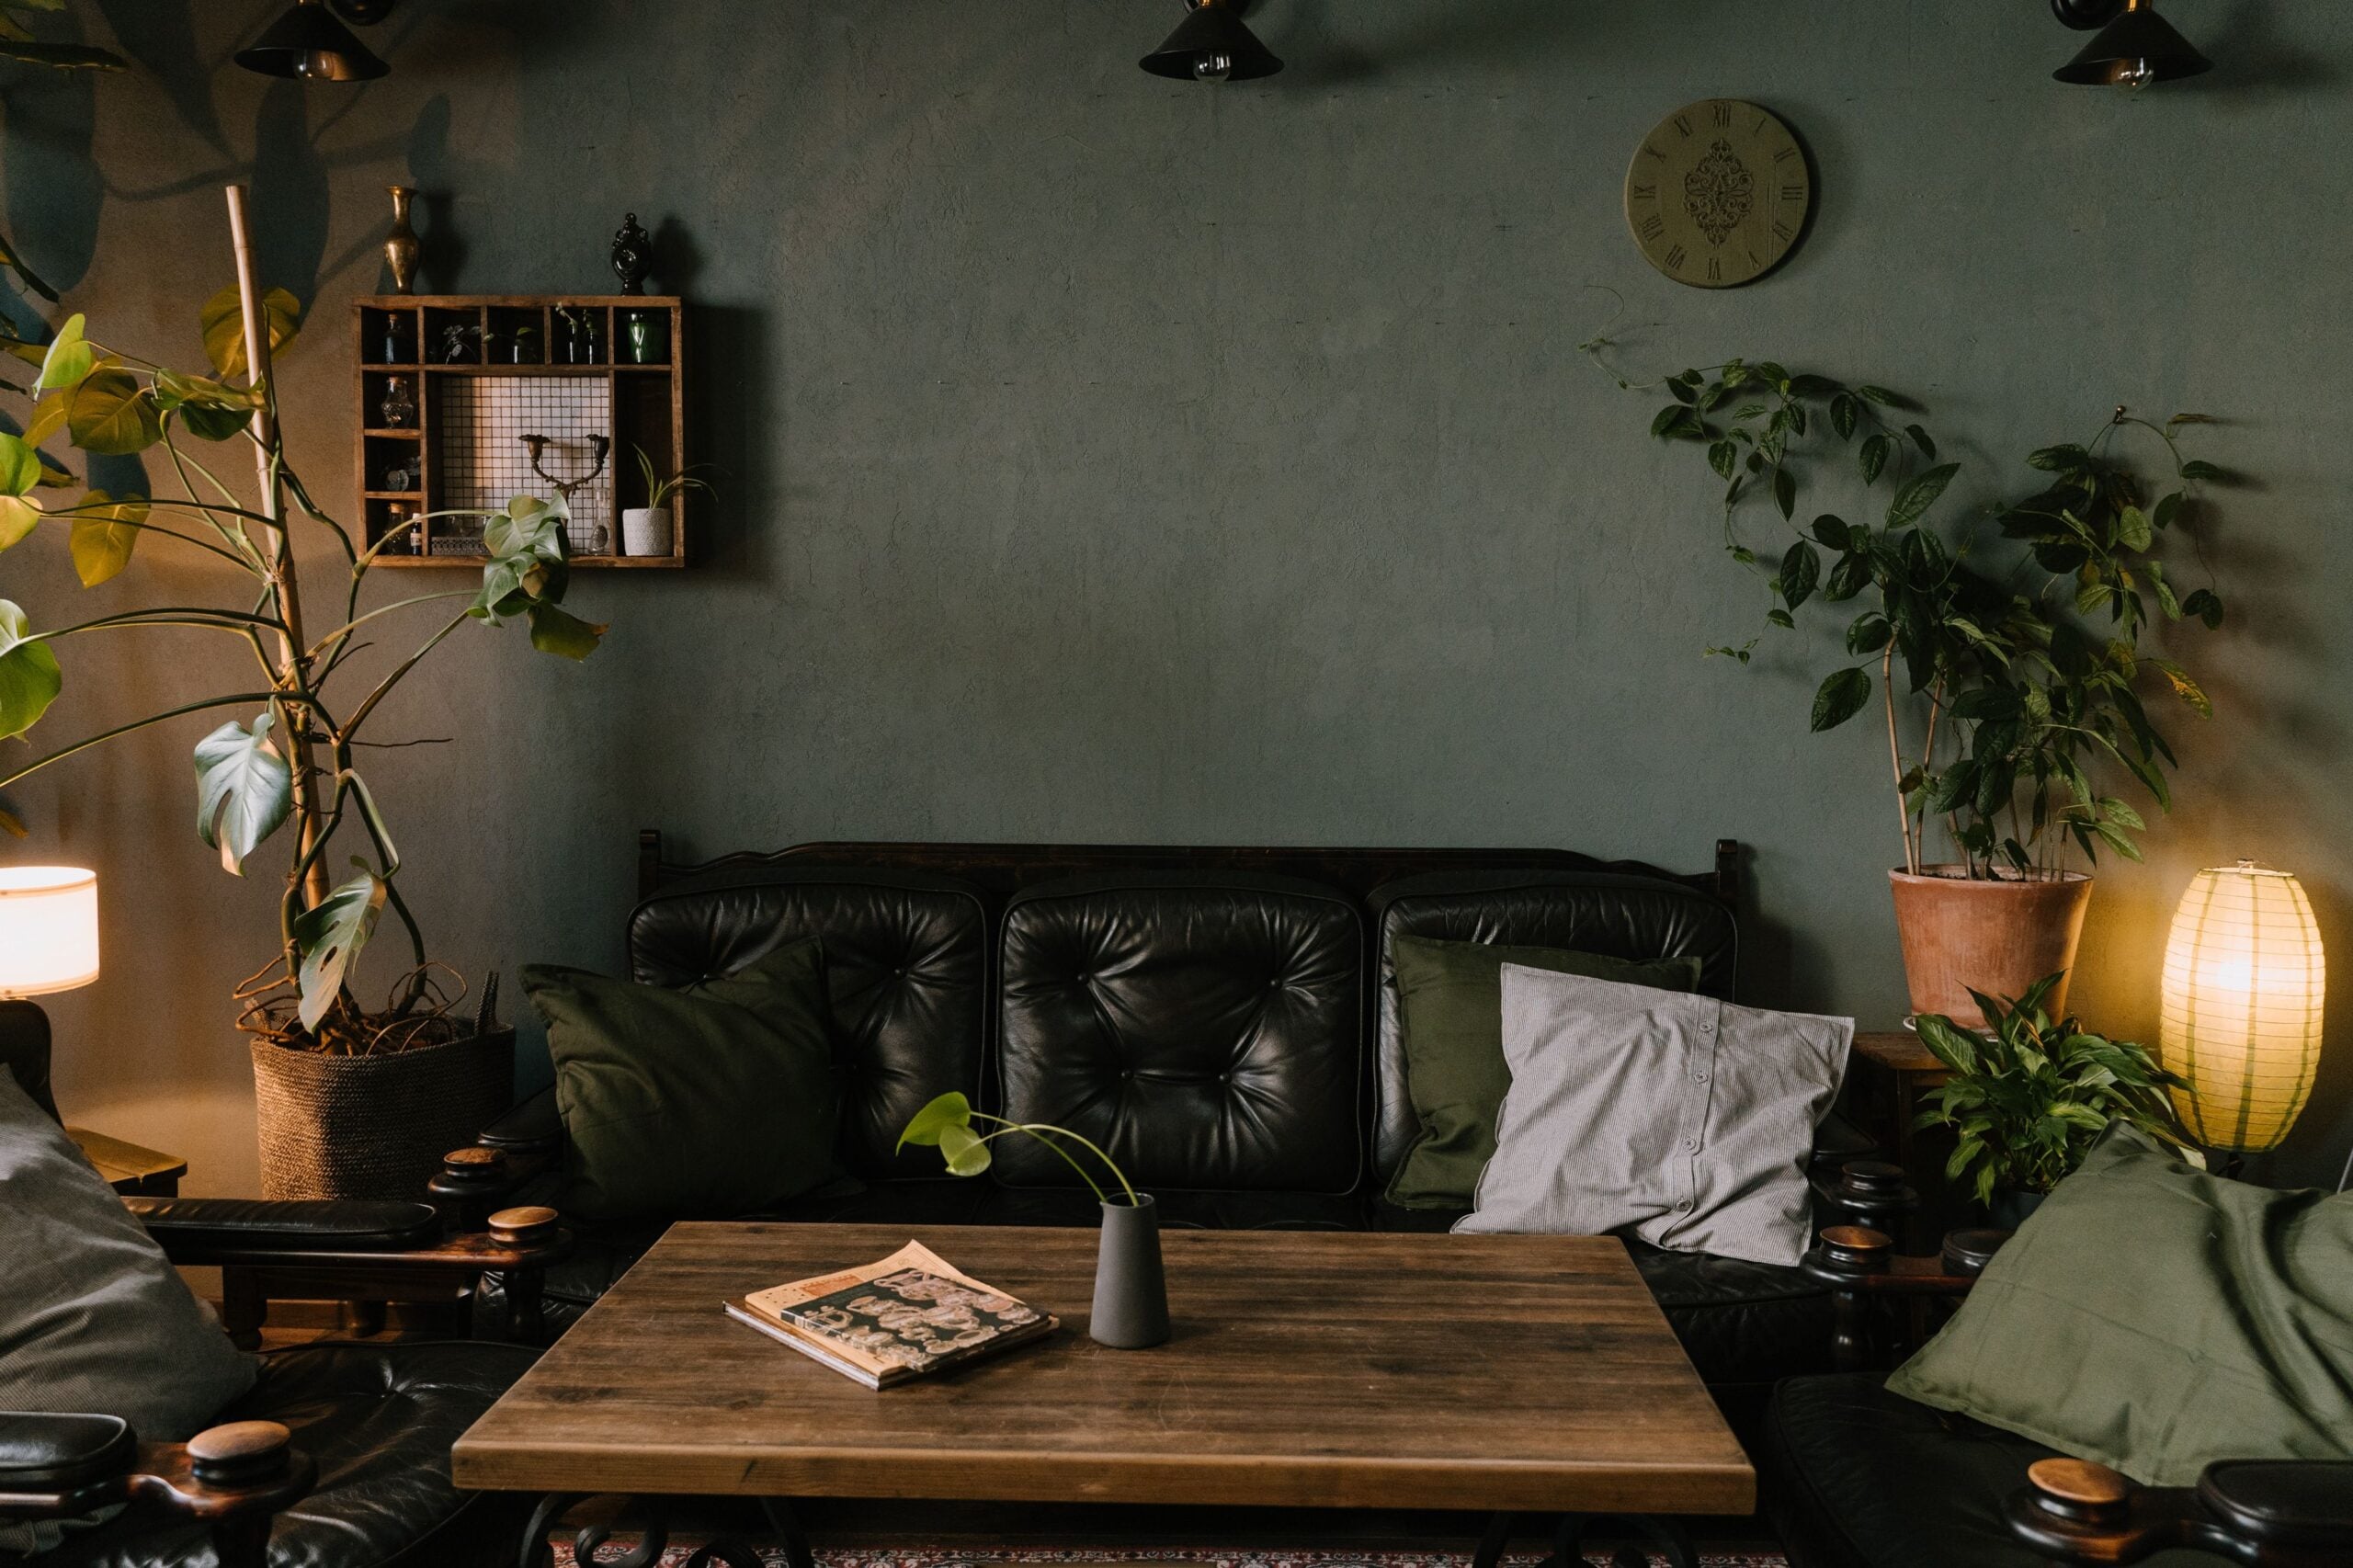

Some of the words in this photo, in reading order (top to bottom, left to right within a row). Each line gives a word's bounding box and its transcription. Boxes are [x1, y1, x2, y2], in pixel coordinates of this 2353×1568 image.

[1713, 103, 1732, 128] XII
[1674, 115, 1694, 138] XI
[1645, 145, 1666, 163] X
[1773, 146, 1796, 164] II
[1633, 185, 1656, 199] IX
[1781, 186, 1803, 200] III
[1706, 257, 1721, 280] VI
